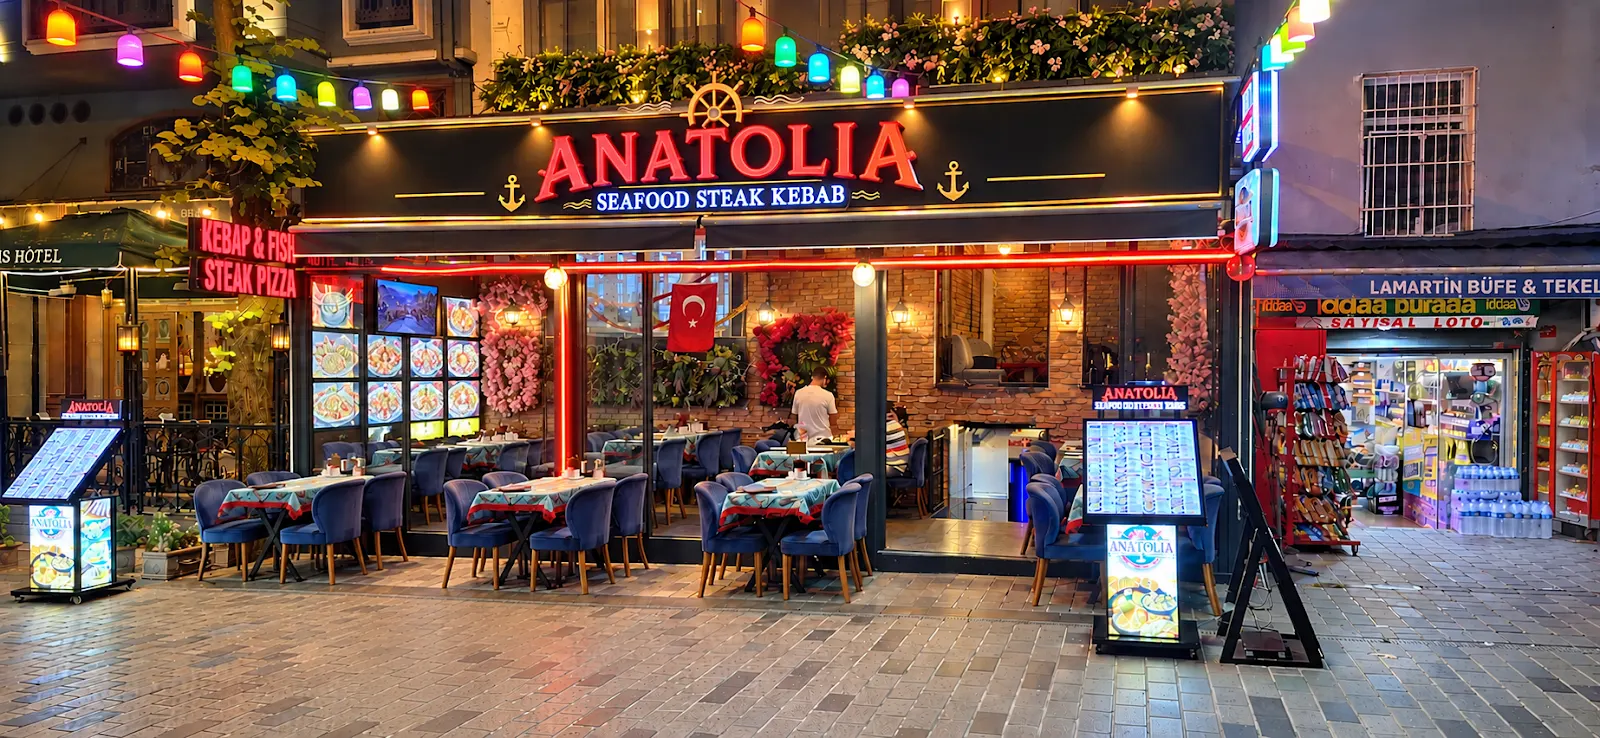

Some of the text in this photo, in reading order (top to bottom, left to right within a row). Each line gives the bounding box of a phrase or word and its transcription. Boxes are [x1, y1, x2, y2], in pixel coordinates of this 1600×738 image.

[534, 121, 923, 202] ANATOLIA
[596, 184, 846, 212] SEAFOOD STEAK KEBAB
[202, 218, 297, 264] KEBAP & FISH
[204, 258, 297, 299] STEAK PIZZA
[1370, 276, 1600, 295] LAMARTİN BÜFE & TEKEL
[1331, 316, 1483, 329] SAYISAL LOTO
[1101, 386, 1178, 402] ANATOLIA
[66, 400, 115, 414] ANATOLIA
[31, 517, 72, 529] ANATOLIA
[1109, 540, 1174, 554] ANATOLIA
